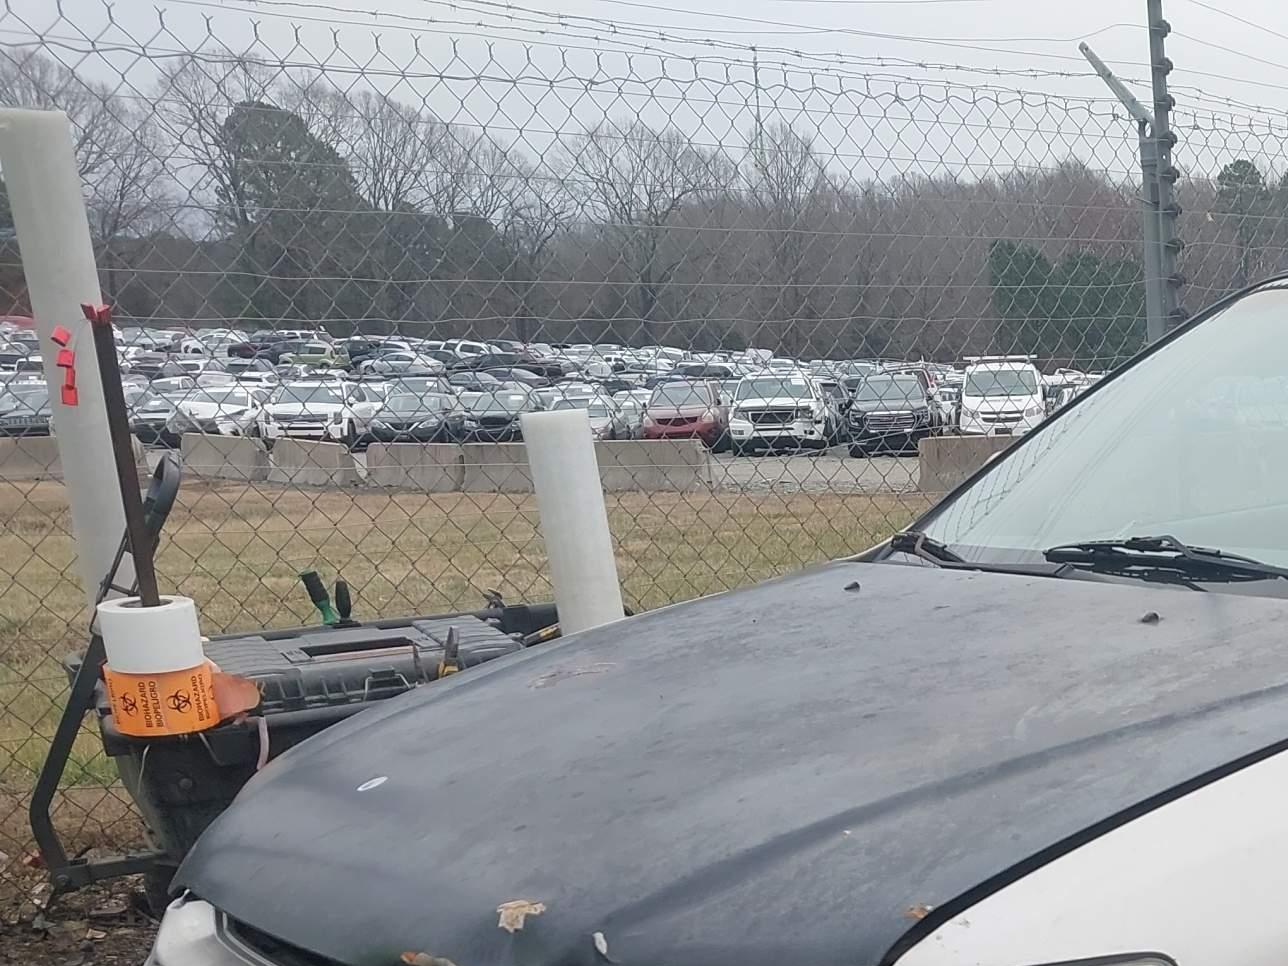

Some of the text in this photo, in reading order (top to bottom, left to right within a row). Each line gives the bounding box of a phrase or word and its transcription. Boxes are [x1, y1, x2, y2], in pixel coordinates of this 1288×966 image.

[138, 682, 154, 727] BIOHAZARD
[148, 680, 165, 727] BIOPELIGRO
[191, 675, 205, 721] BIOHAZARD
